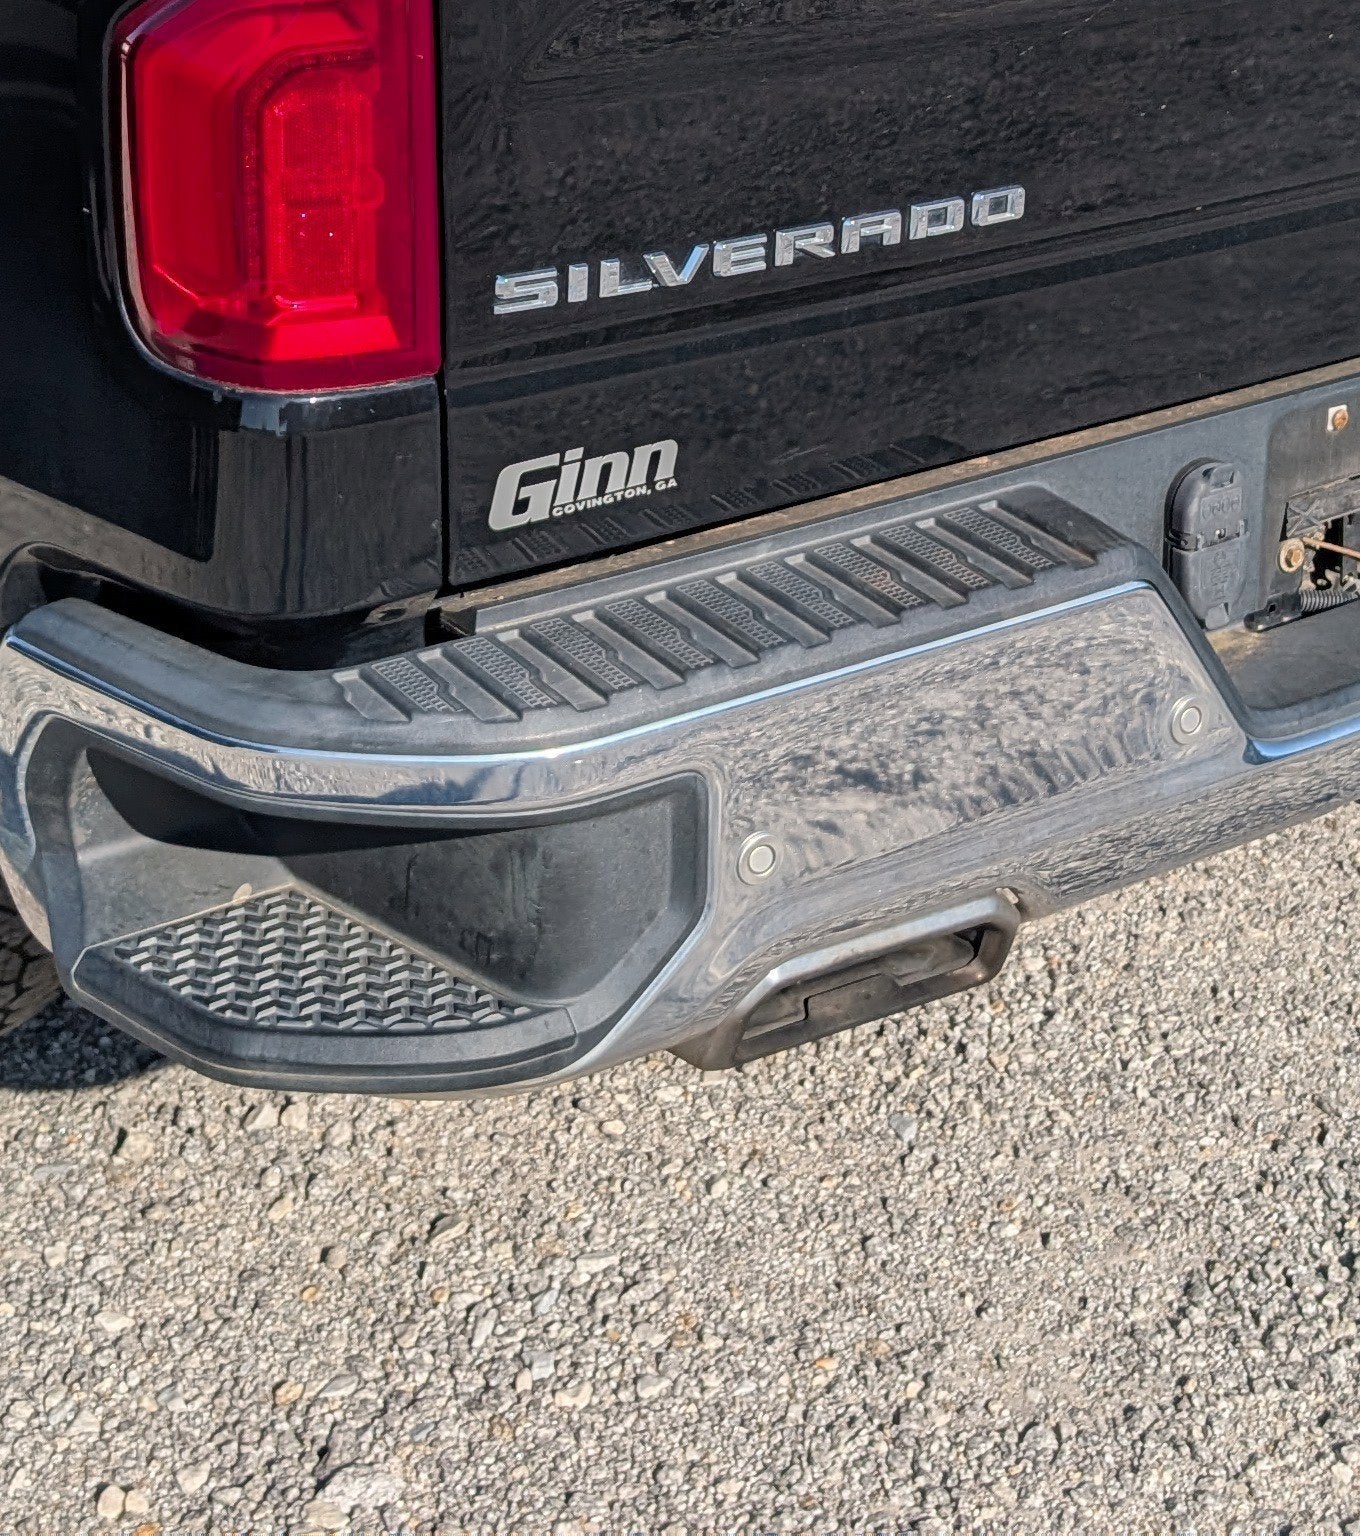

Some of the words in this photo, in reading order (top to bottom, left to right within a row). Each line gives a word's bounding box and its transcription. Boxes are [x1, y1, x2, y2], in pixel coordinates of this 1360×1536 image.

[493, 184, 1026, 315] SILVERADO
[489, 439, 679, 531] Ginn
[551, 485, 652, 517] COVINGTON,
[654, 477, 678, 491] GA
